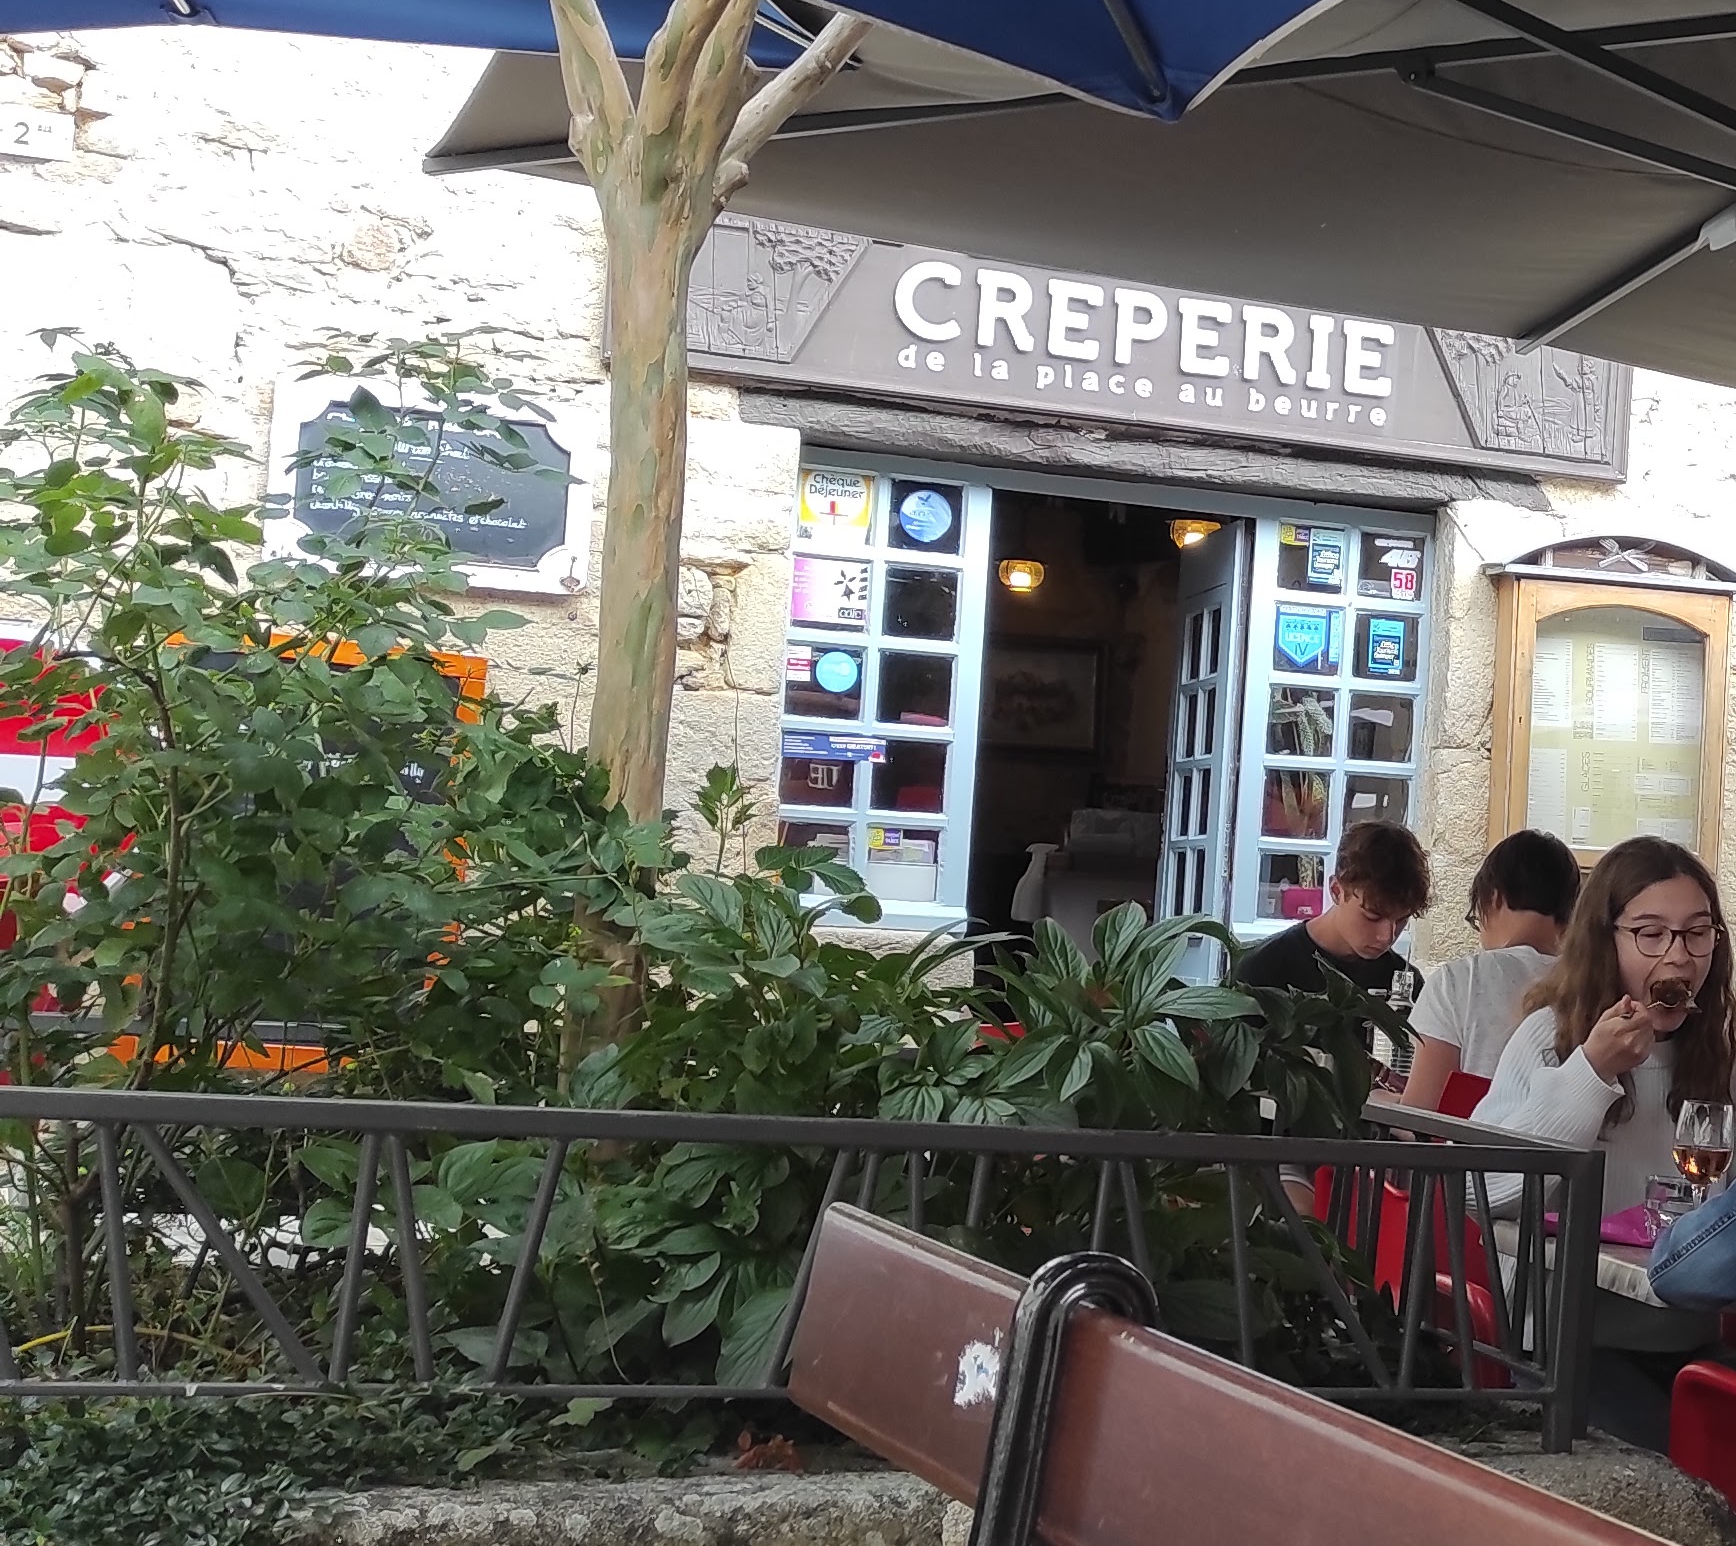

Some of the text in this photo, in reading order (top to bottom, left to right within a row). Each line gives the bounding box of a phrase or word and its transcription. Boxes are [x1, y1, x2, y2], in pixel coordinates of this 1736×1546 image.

[13, 121, 30, 145] 2
[893, 261, 1396, 399] CREPERIE
[897, 344, 1388, 428] de la place au beurre
